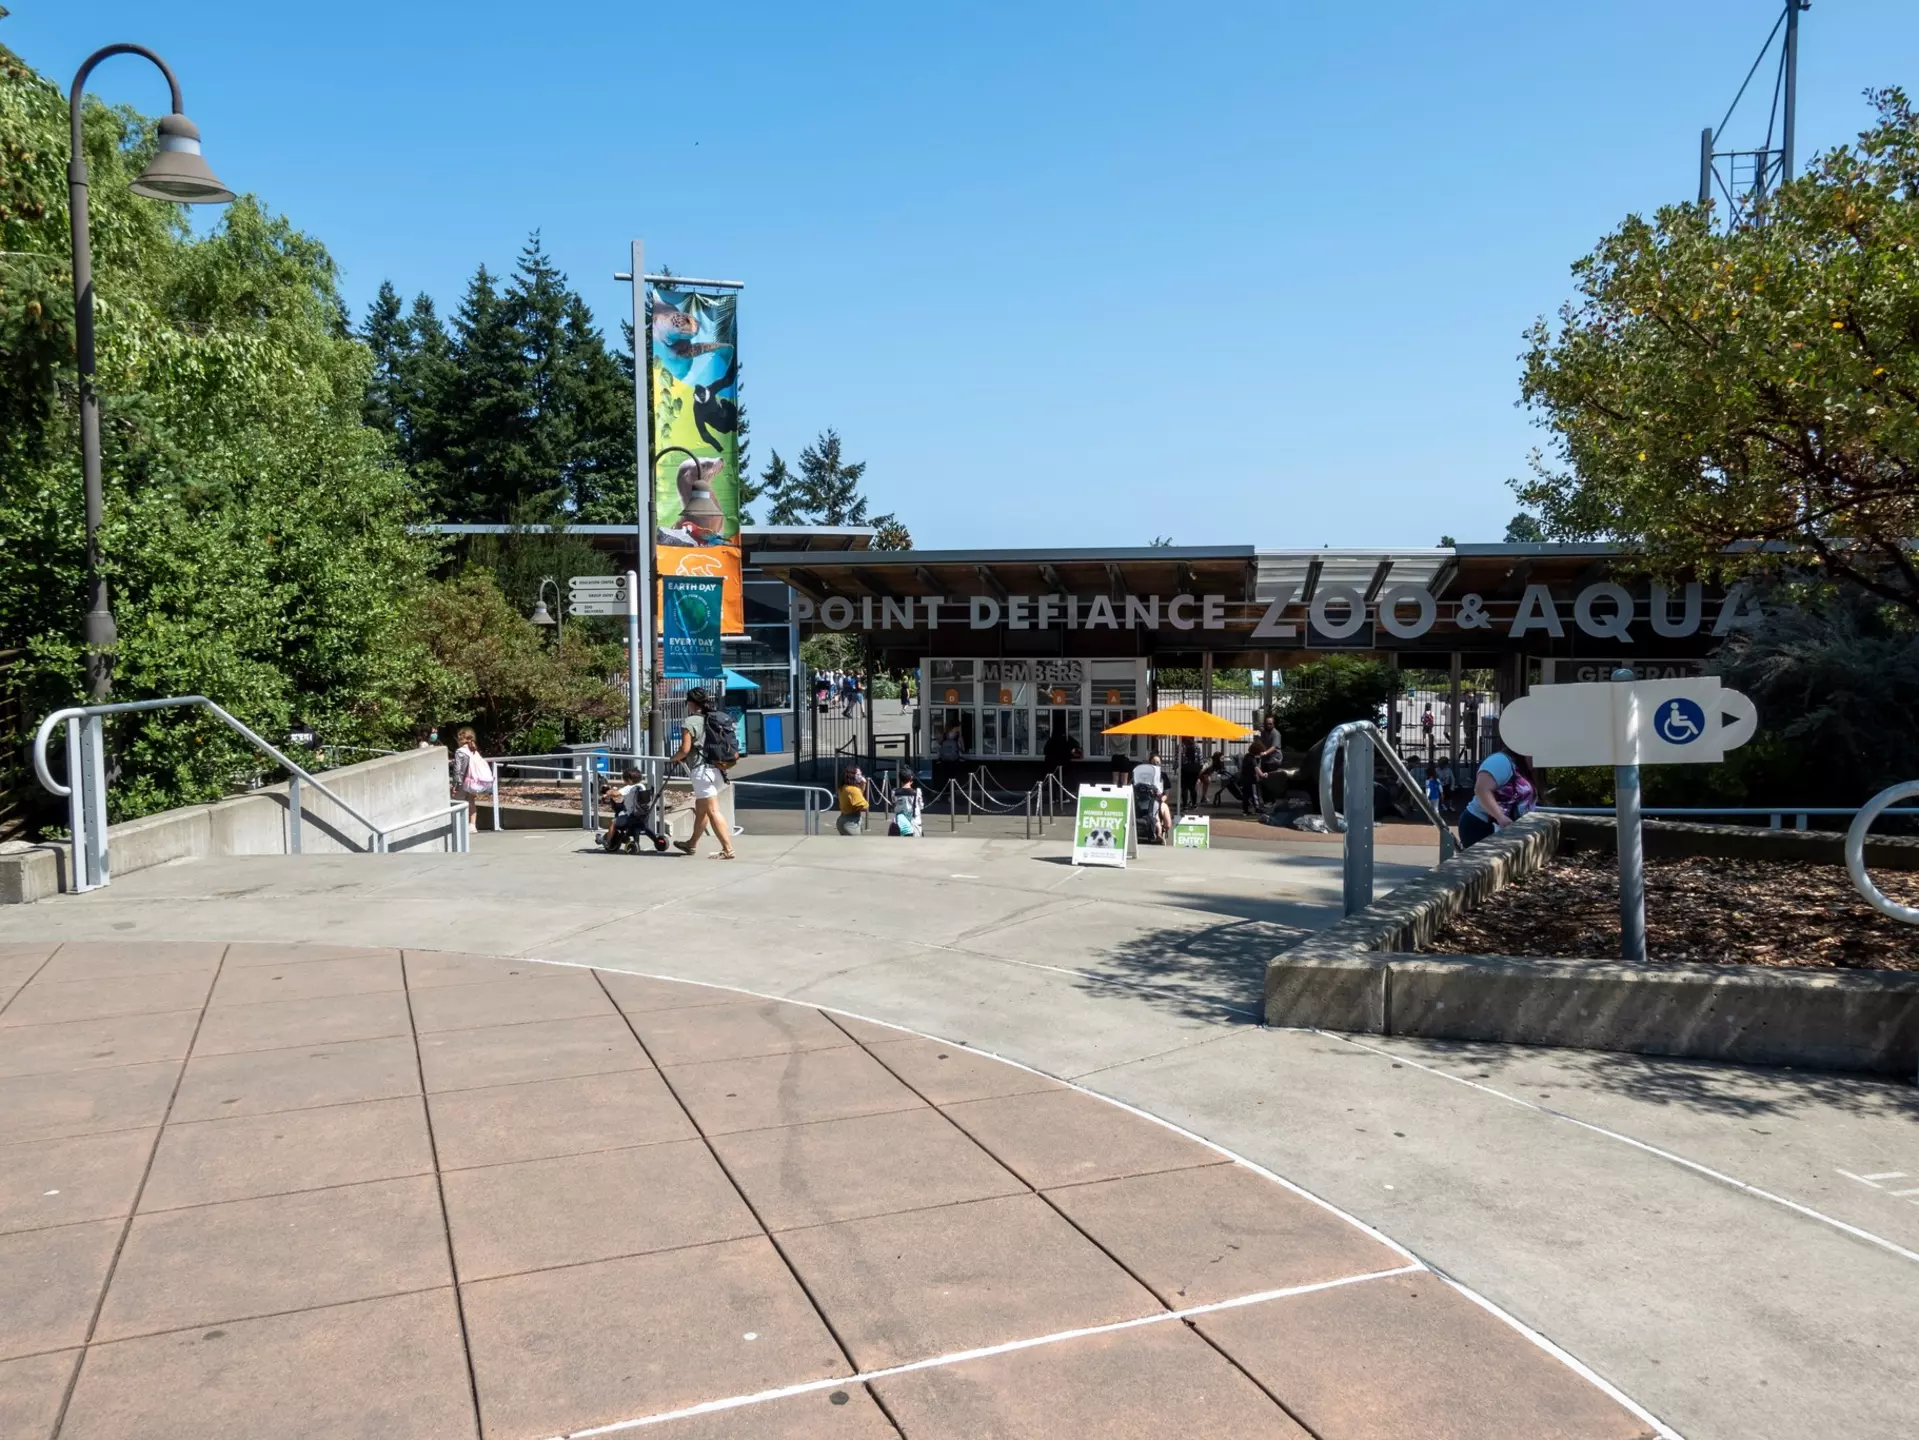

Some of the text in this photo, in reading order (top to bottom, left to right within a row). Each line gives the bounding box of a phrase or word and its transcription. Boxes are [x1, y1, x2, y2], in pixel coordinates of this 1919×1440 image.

[668, 582, 717, 592] EARTH DAY
[791, 595, 945, 631] POINT
[970, 594, 1226, 631] DEFIANCE
[1251, 584, 1437, 640] ZOO
[1455, 593, 1492, 630] &
[669, 637, 714, 647] EVERY DAY
[984, 664, 1082, 682] MEMBERS
[1577, 666, 1690, 682] GEERAL
[1082, 816, 1123, 830] ENTRY
[1178, 836, 1205, 845] ENTRY
